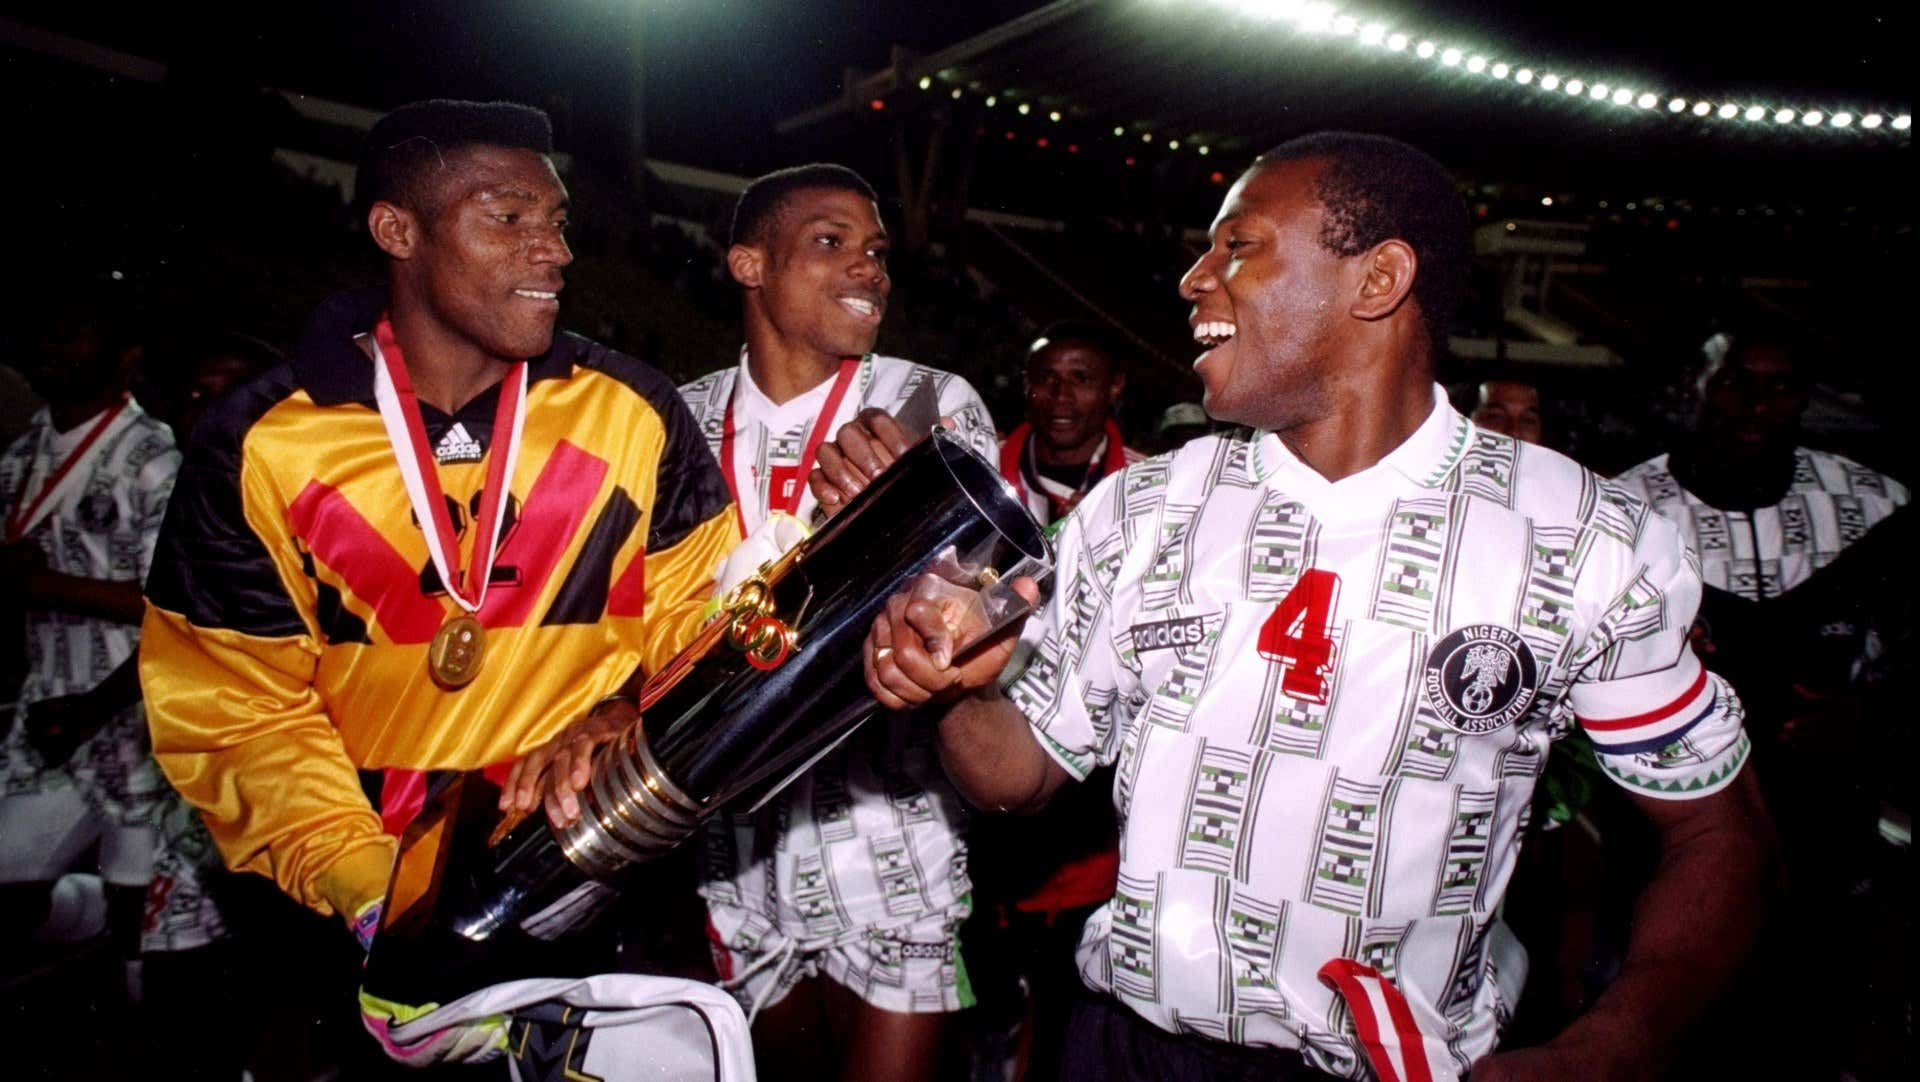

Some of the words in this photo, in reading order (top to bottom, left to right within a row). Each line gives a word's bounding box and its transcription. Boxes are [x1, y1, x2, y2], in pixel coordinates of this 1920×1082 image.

[437, 440, 481, 457] adidas
[1134, 622, 1202, 648] adidas
[1256, 568, 1342, 705] 4
[1462, 625, 1521, 652] NIGERIA
[1427, 667, 1459, 726] FOOTBALL
[1461, 687, 1533, 732] ASSOCIATION
